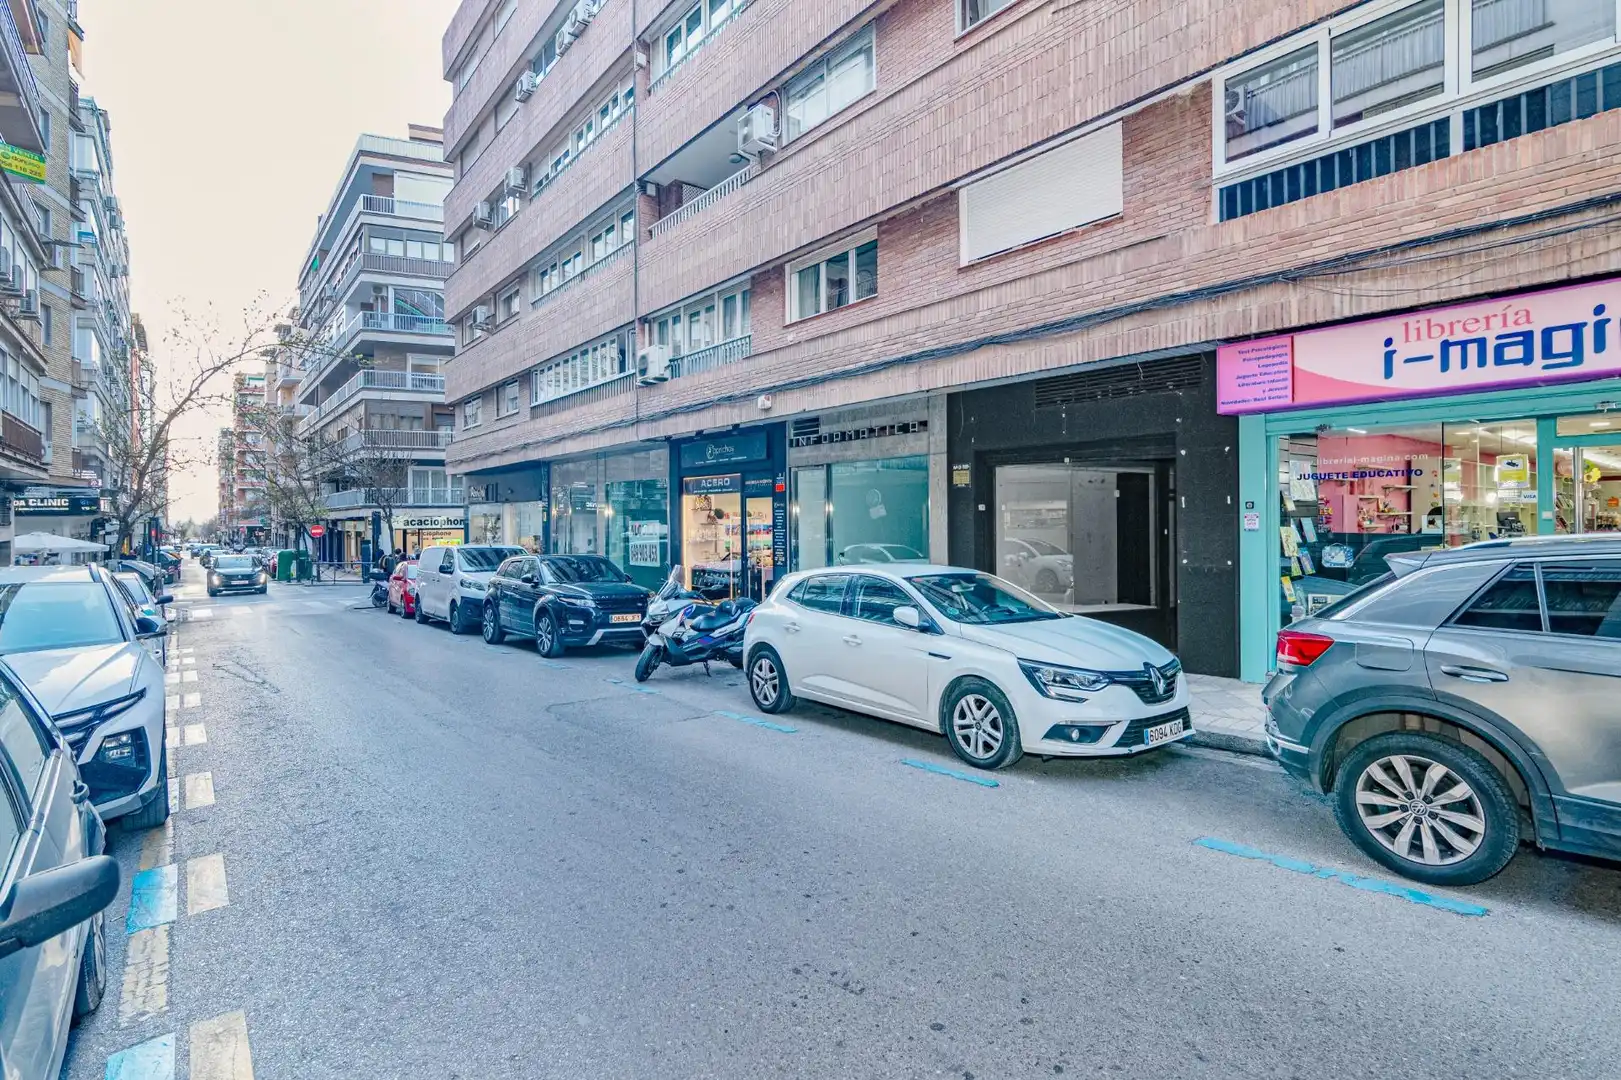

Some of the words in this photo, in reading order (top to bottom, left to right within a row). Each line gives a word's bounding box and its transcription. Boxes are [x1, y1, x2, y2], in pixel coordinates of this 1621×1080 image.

[1403, 304, 1534, 343] librería
[1383, 303, 1621, 380] i-magi
[793, 421, 918, 447] INFORMATICA
[701, 477, 730, 487] ACERO
[1297, 471, 1348, 481] JUGUETE
[1352, 469, 1423, 479] EDUCATIVO
[1150, 726, 1167, 742] 6094
